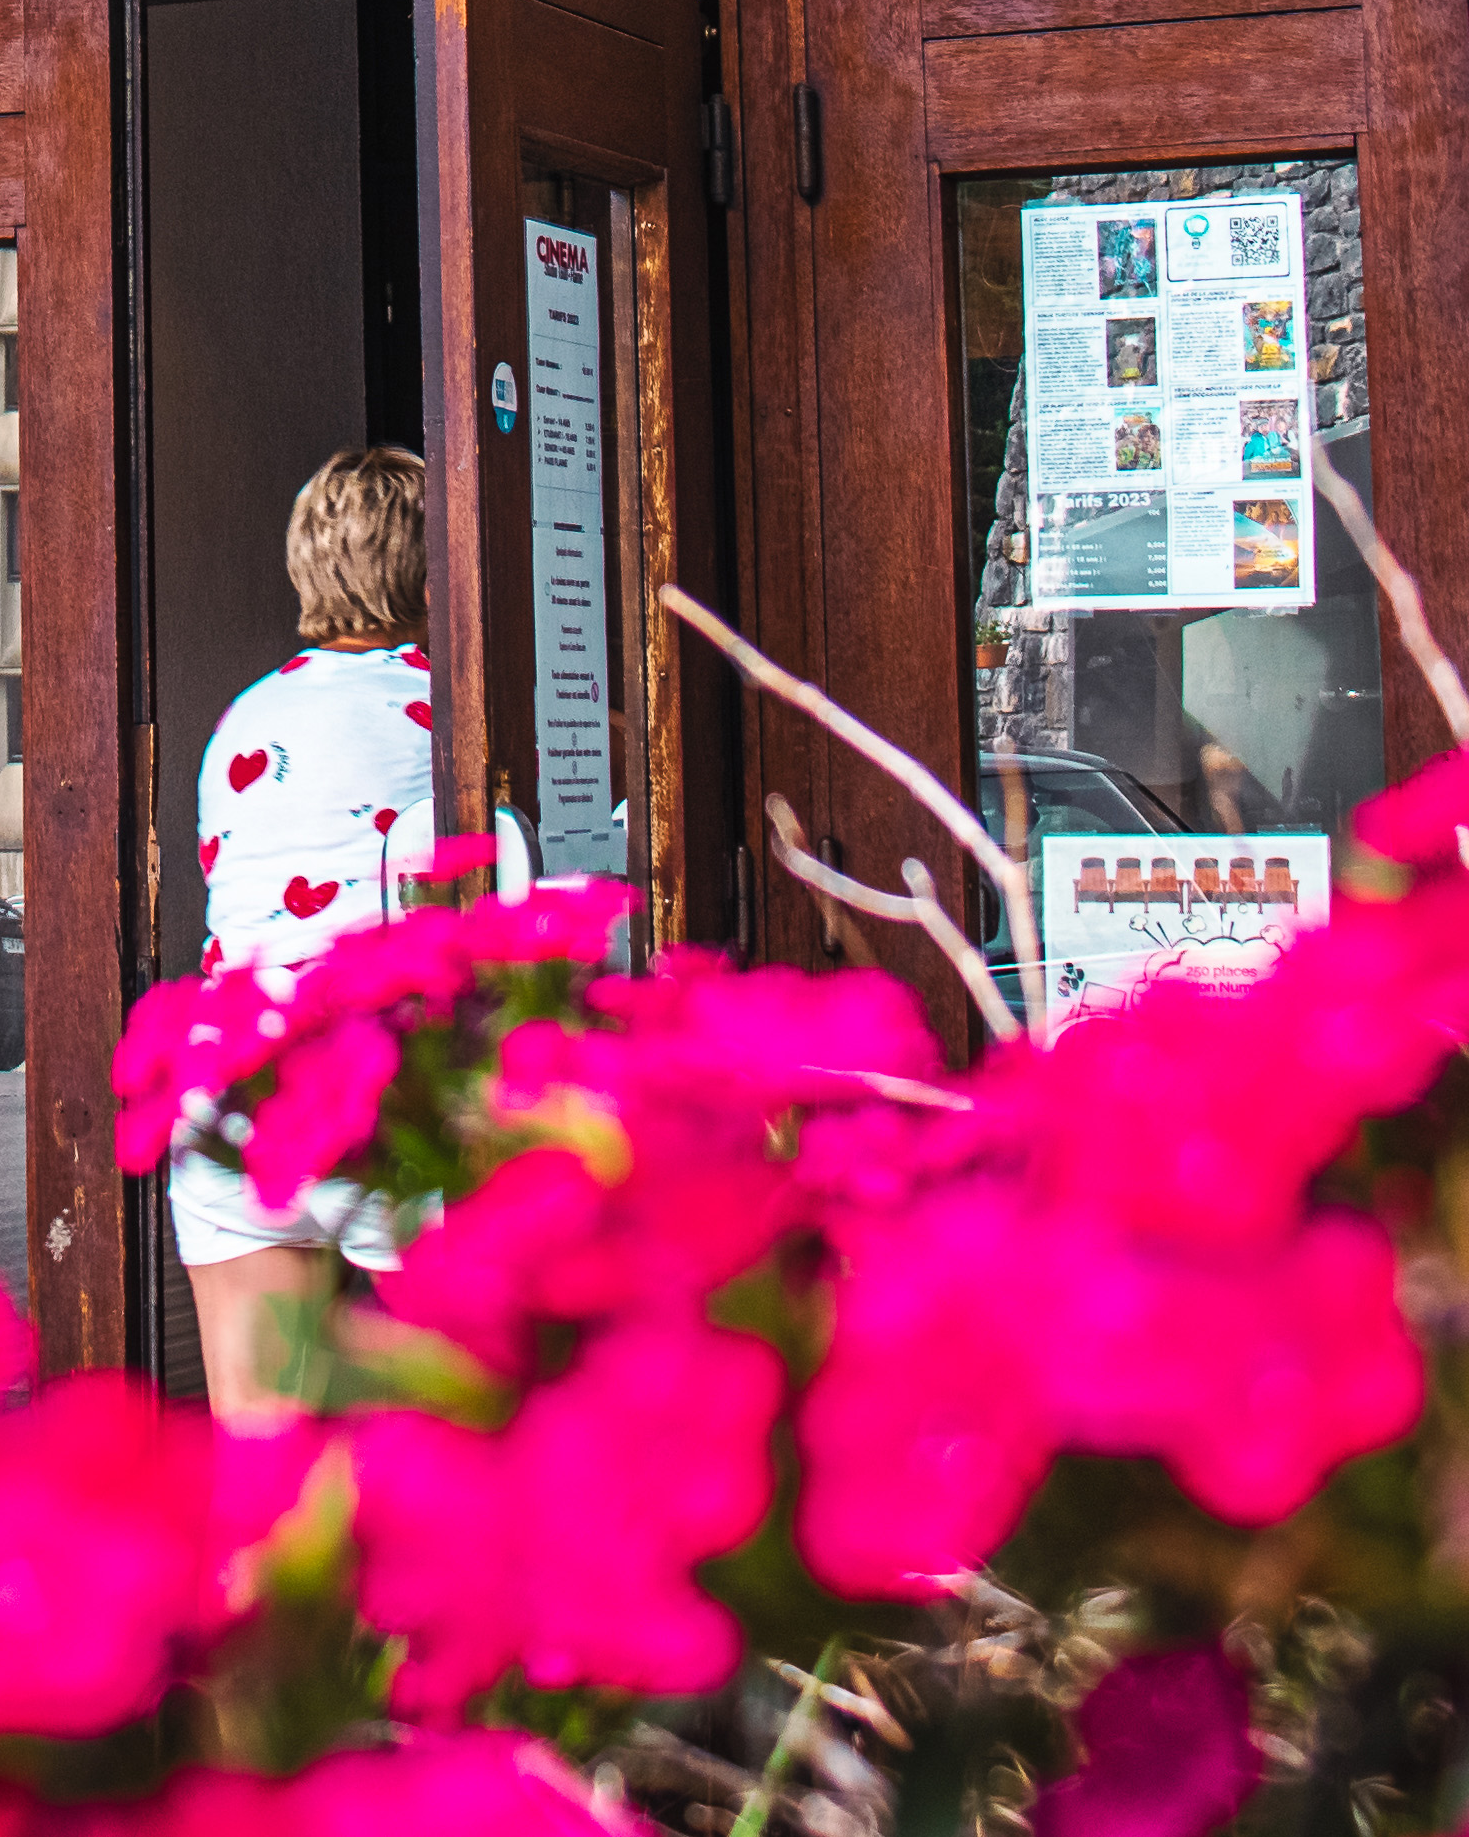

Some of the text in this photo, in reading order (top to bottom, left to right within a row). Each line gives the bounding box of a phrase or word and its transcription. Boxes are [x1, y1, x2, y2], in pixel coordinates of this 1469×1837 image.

[536, 235, 590, 275] CINEMA
[1107, 492, 1151, 508] 2023
[1186, 964, 1258, 980] 250 places
